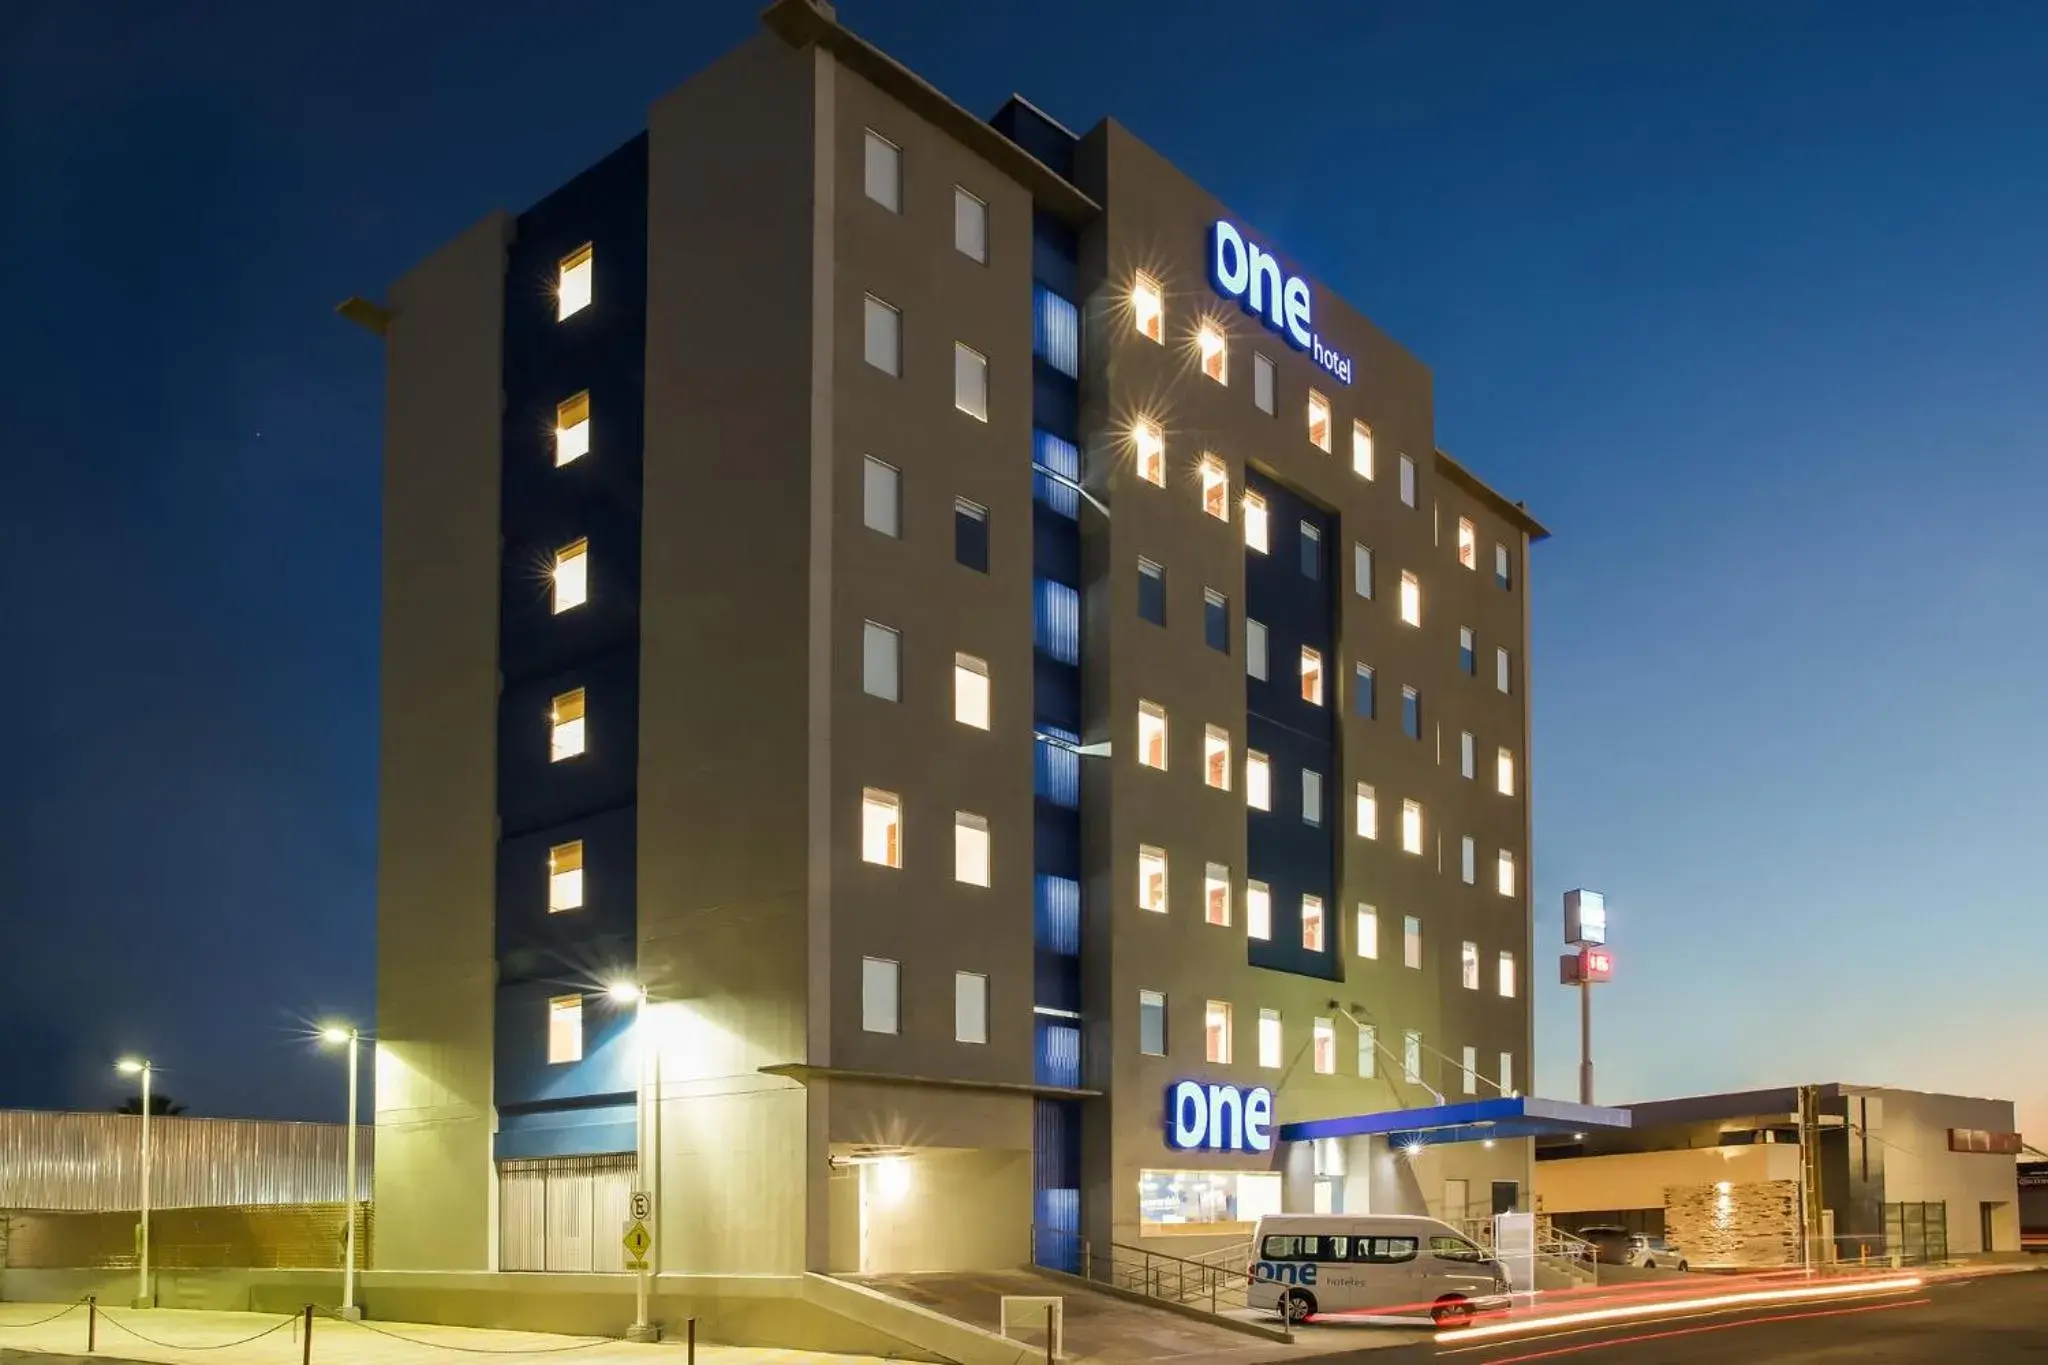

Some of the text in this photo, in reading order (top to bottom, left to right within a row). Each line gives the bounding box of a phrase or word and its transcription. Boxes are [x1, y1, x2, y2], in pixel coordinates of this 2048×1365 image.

[1217, 221, 1311, 347] one
[1315, 334, 1351, 383] hotel
[1177, 1081, 1270, 1150] one
[1256, 1261, 1316, 1285] one
